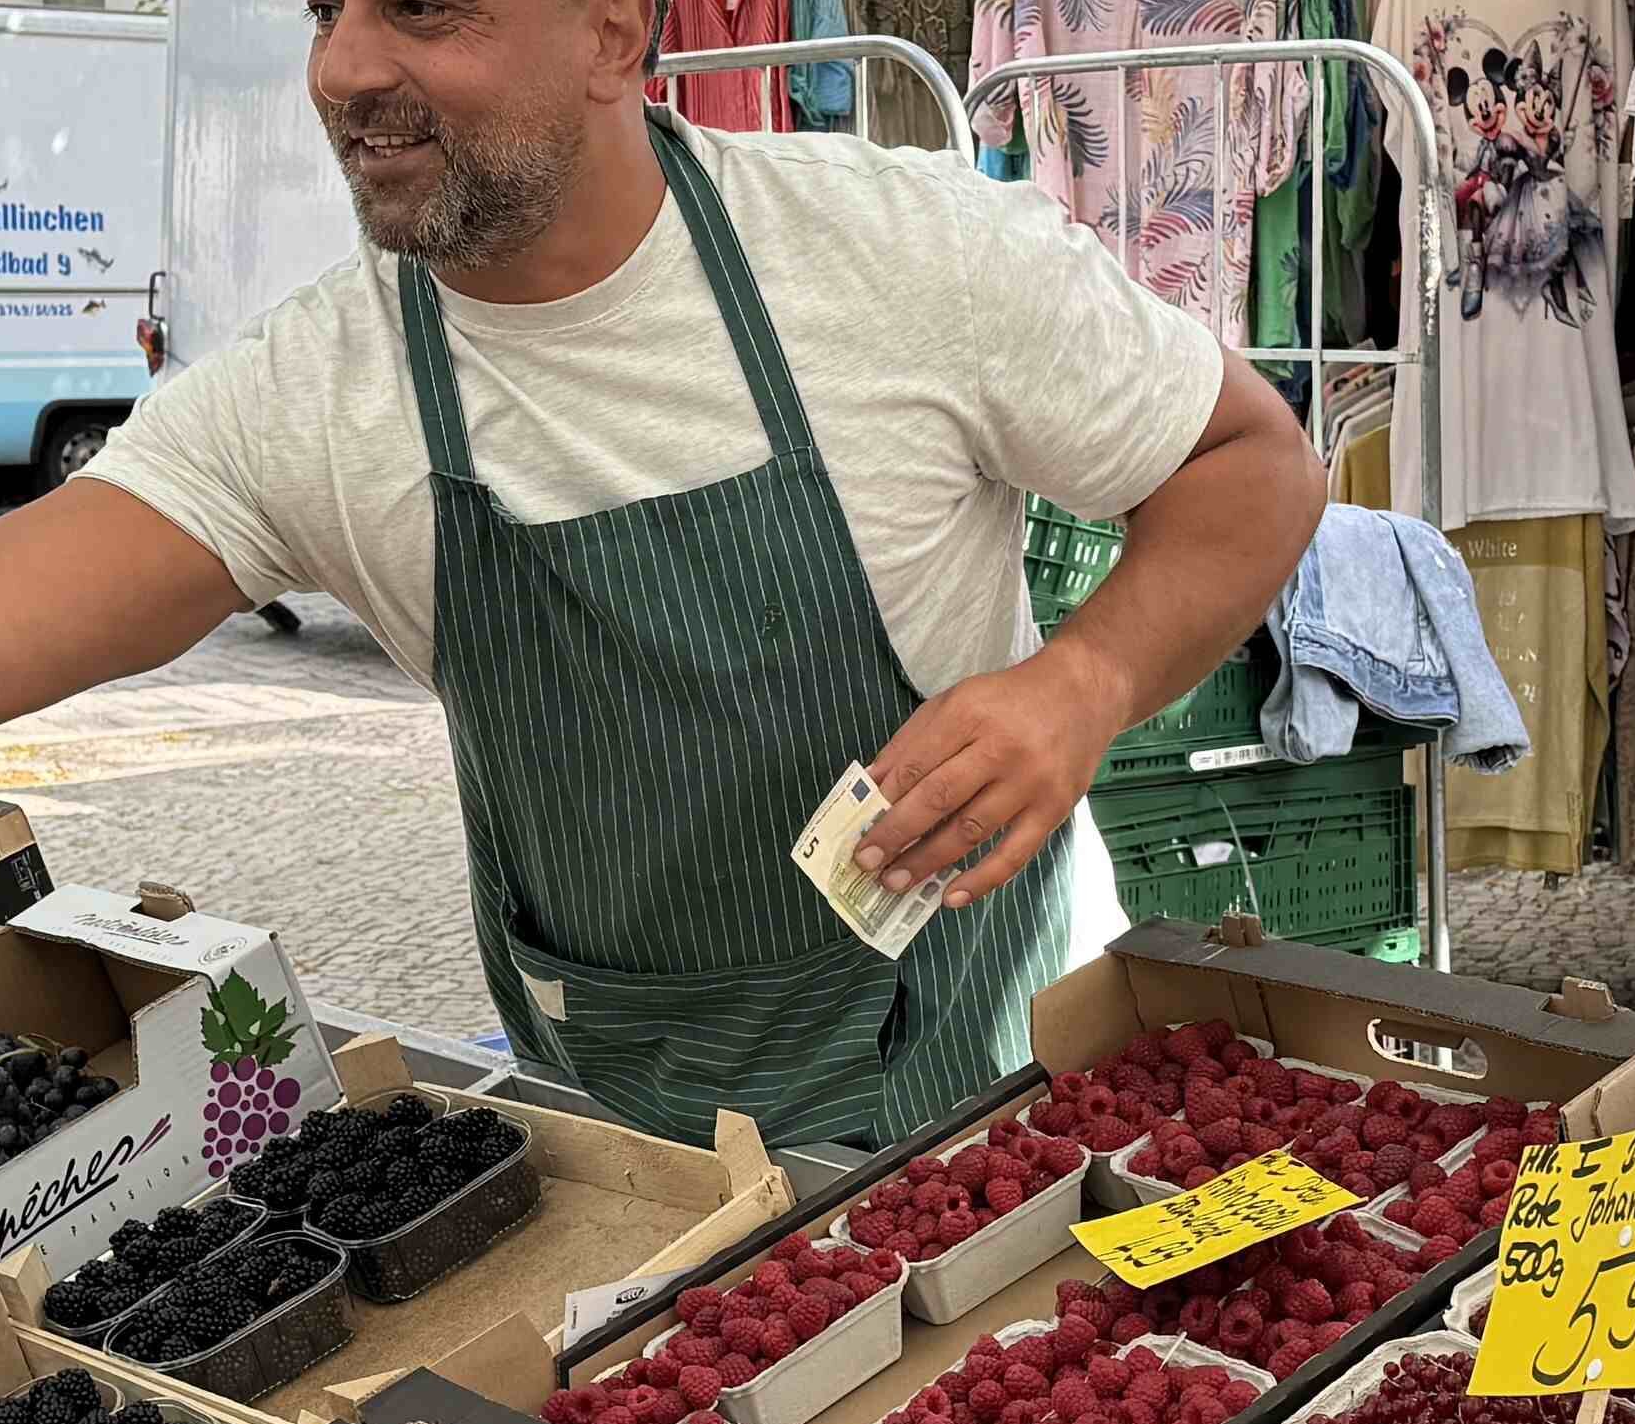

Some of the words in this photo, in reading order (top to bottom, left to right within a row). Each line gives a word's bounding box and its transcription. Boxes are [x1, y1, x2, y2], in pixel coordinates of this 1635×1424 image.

[57, 251, 71, 277] 9
[1468, 539, 1518, 559] White
[802, 835, 820, 860] 5
[1571, 1137, 1613, 1179] I
[70, 1154, 190, 1238] PASSION
[1507, 1181, 1563, 1230] Rote
[1500, 1237, 1565, 1299] 500g
